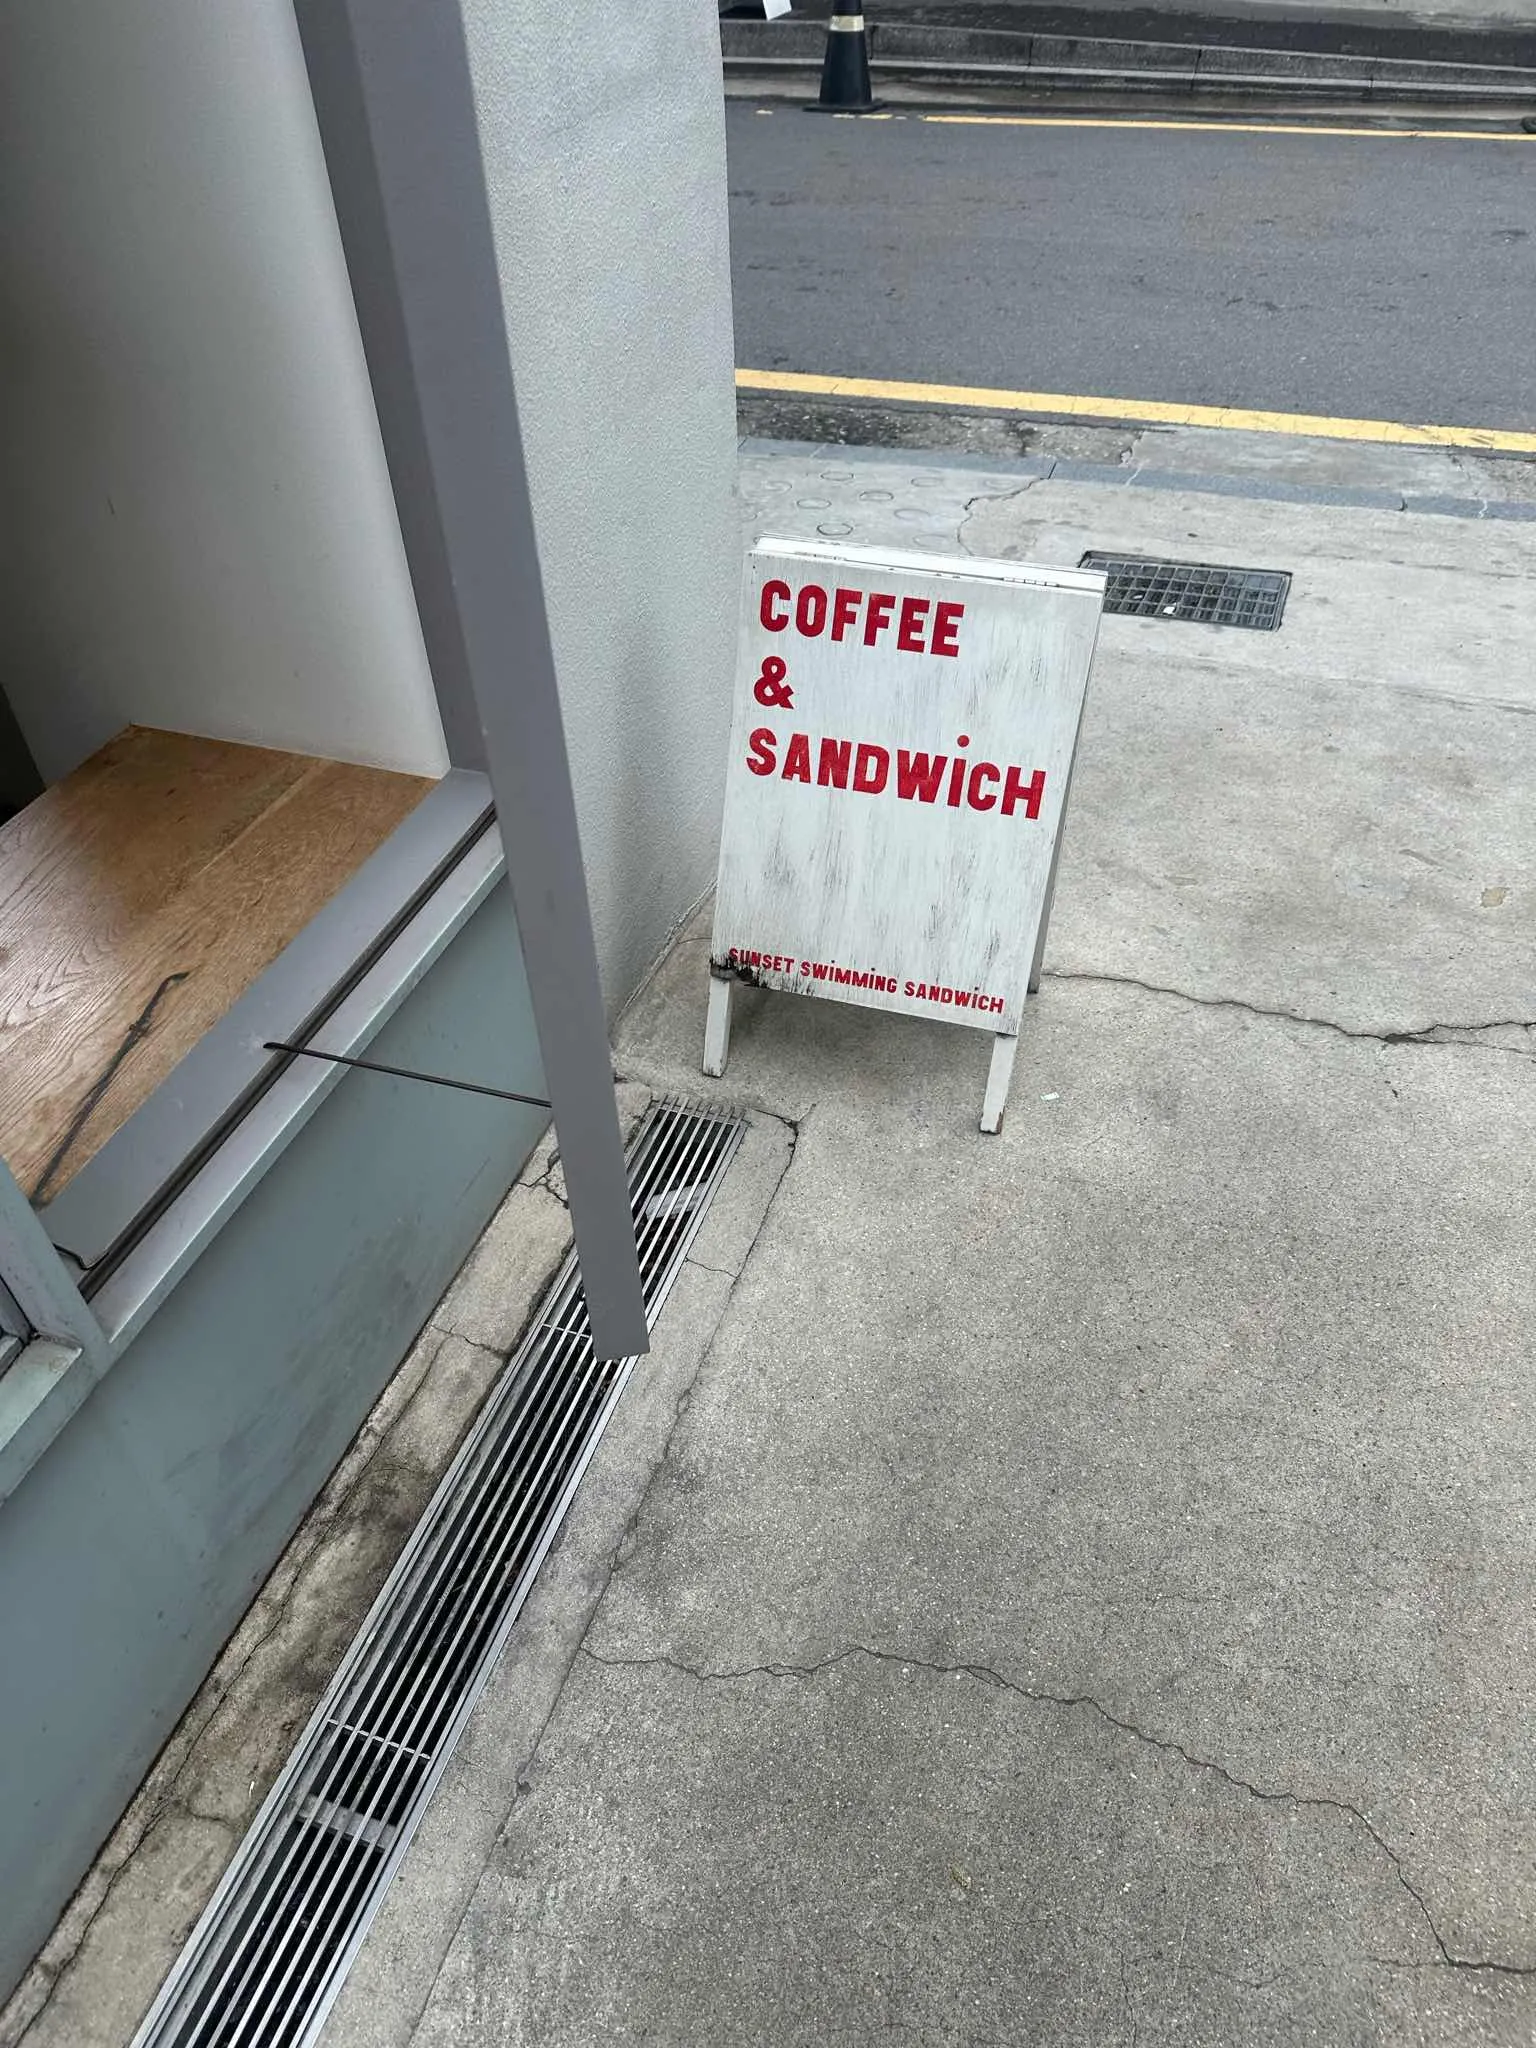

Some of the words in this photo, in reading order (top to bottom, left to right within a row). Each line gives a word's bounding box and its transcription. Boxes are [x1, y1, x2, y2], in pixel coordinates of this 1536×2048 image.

[760, 580, 964, 657] COFFEE
[754, 656, 794, 709] &
[729, 948, 794, 973] SUNSET
